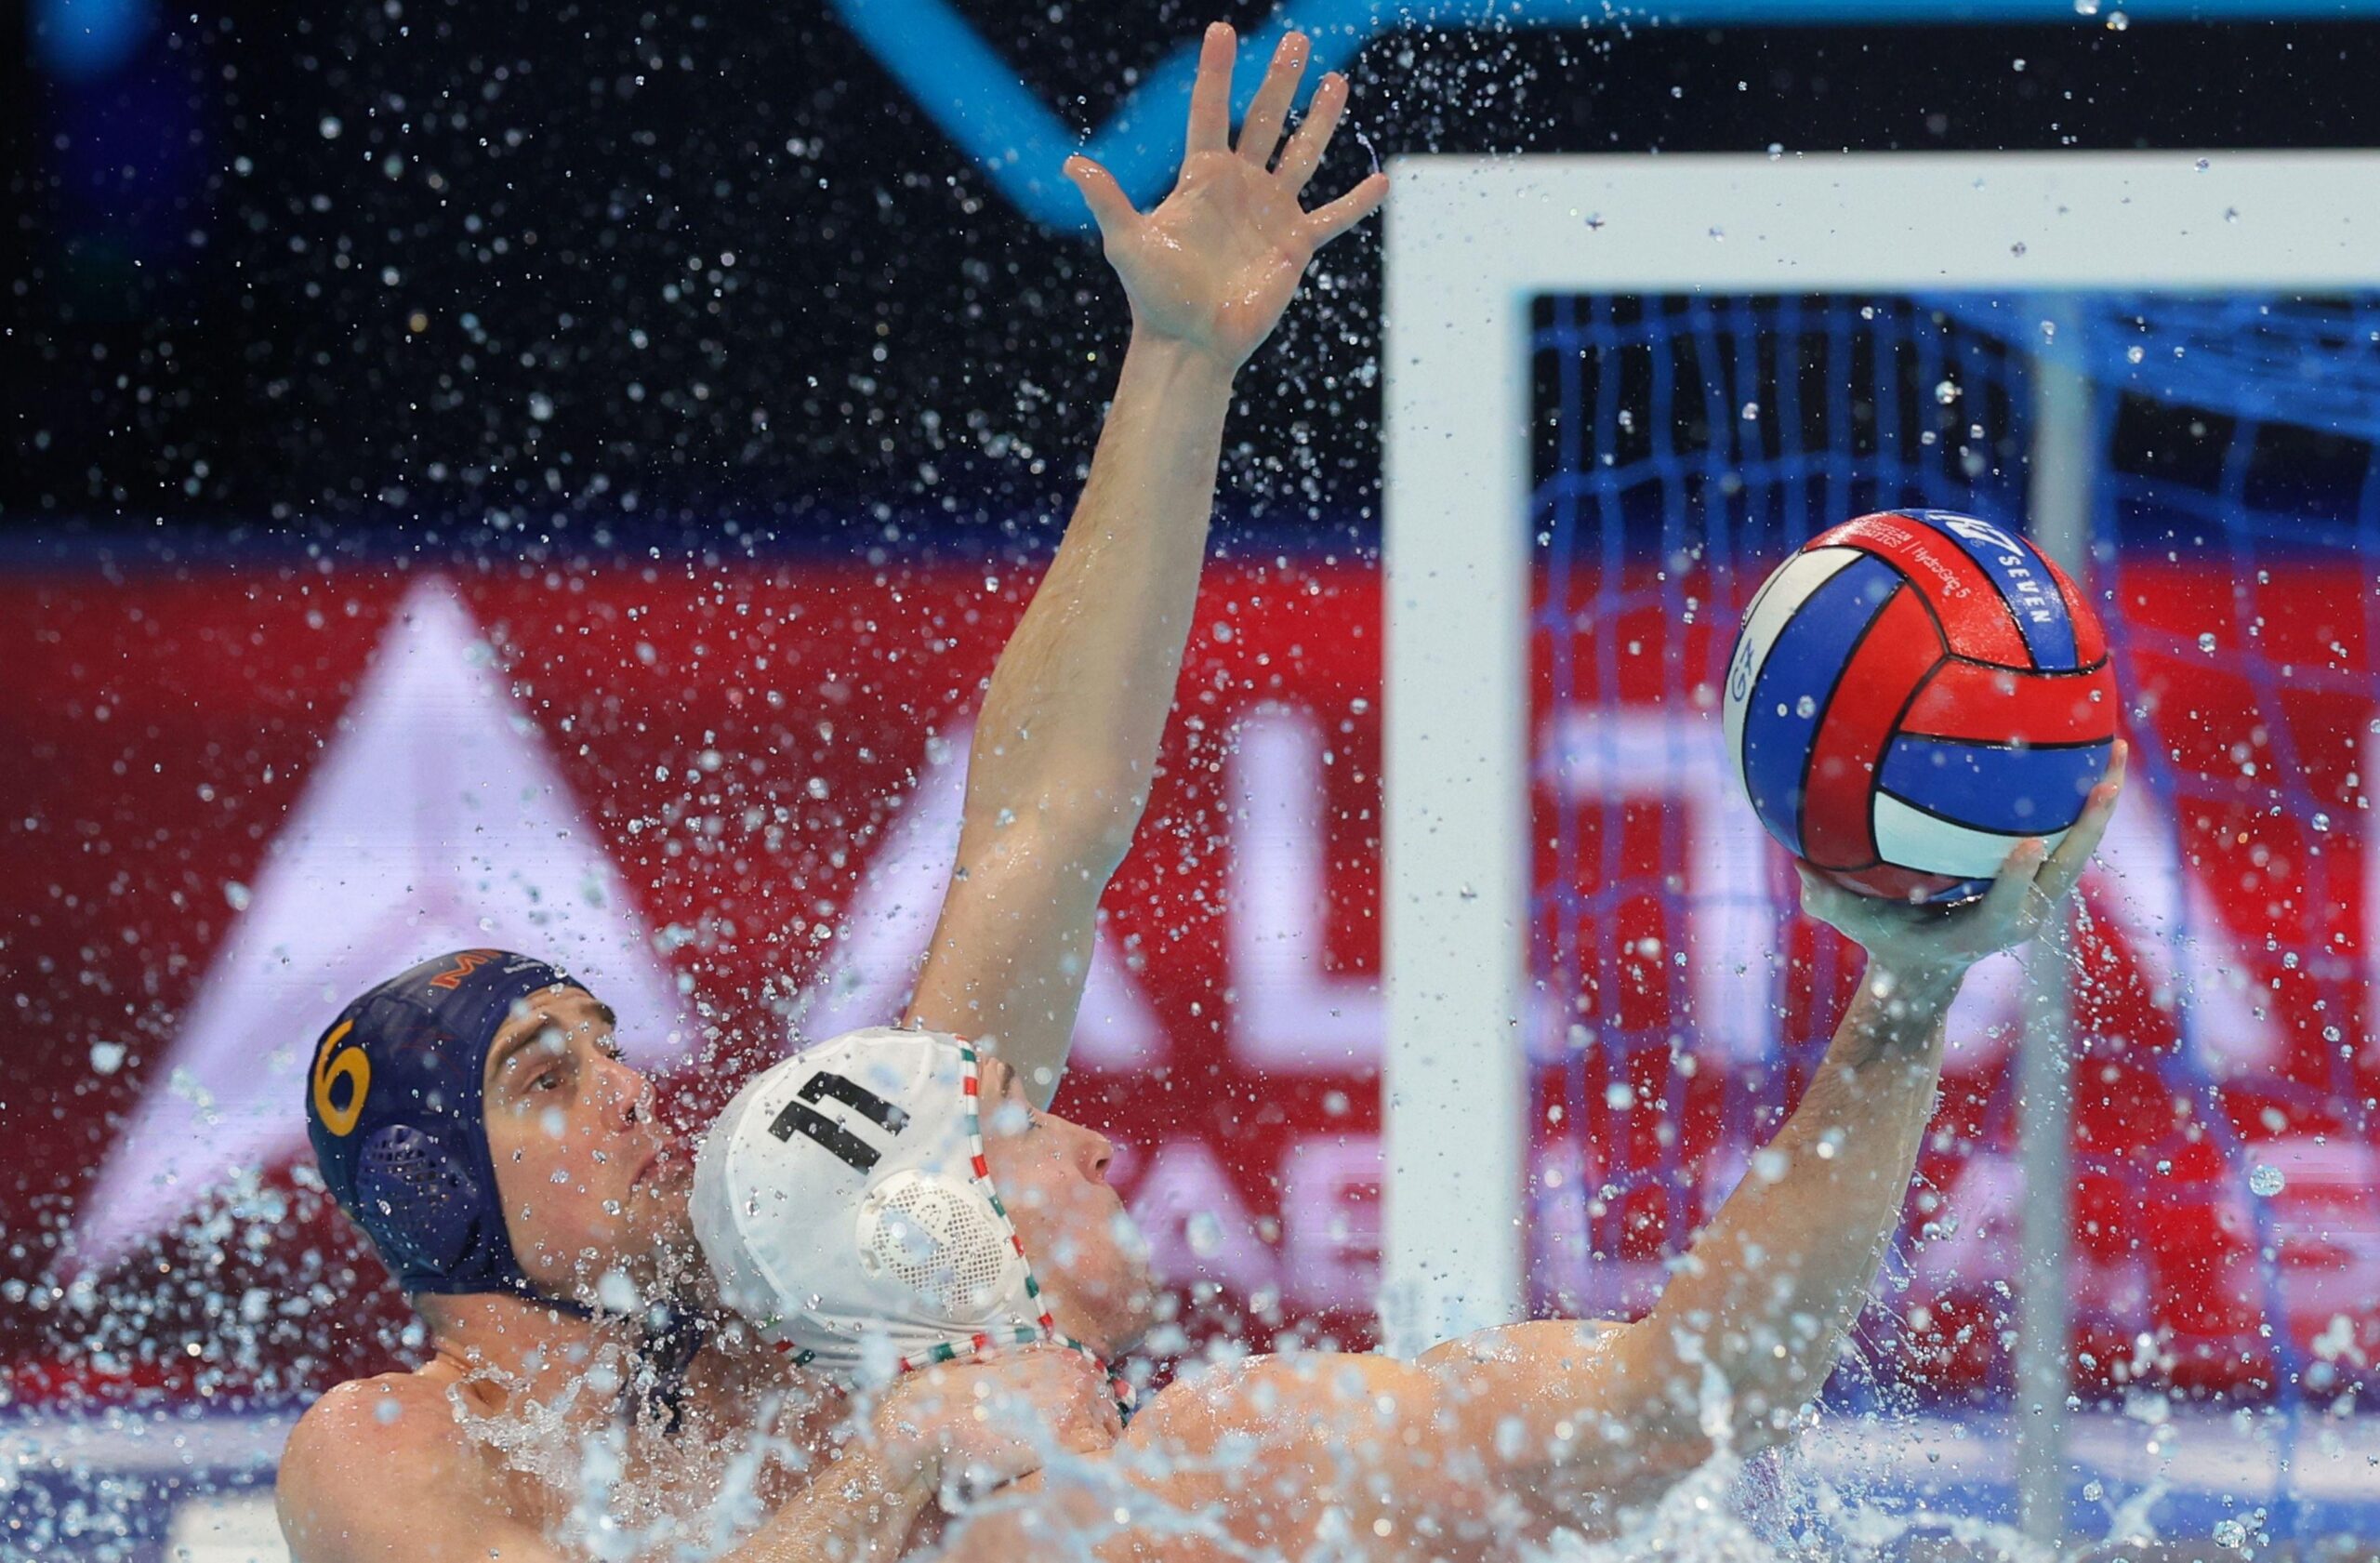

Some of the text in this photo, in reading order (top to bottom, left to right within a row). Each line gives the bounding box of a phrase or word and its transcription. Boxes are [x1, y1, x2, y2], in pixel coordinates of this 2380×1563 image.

[1956, 587, 1972, 600] 5
[1998, 555, 2052, 624] SEVEN
[312, 1019, 371, 1137] 6
[768, 1070, 911, 1176] 11
